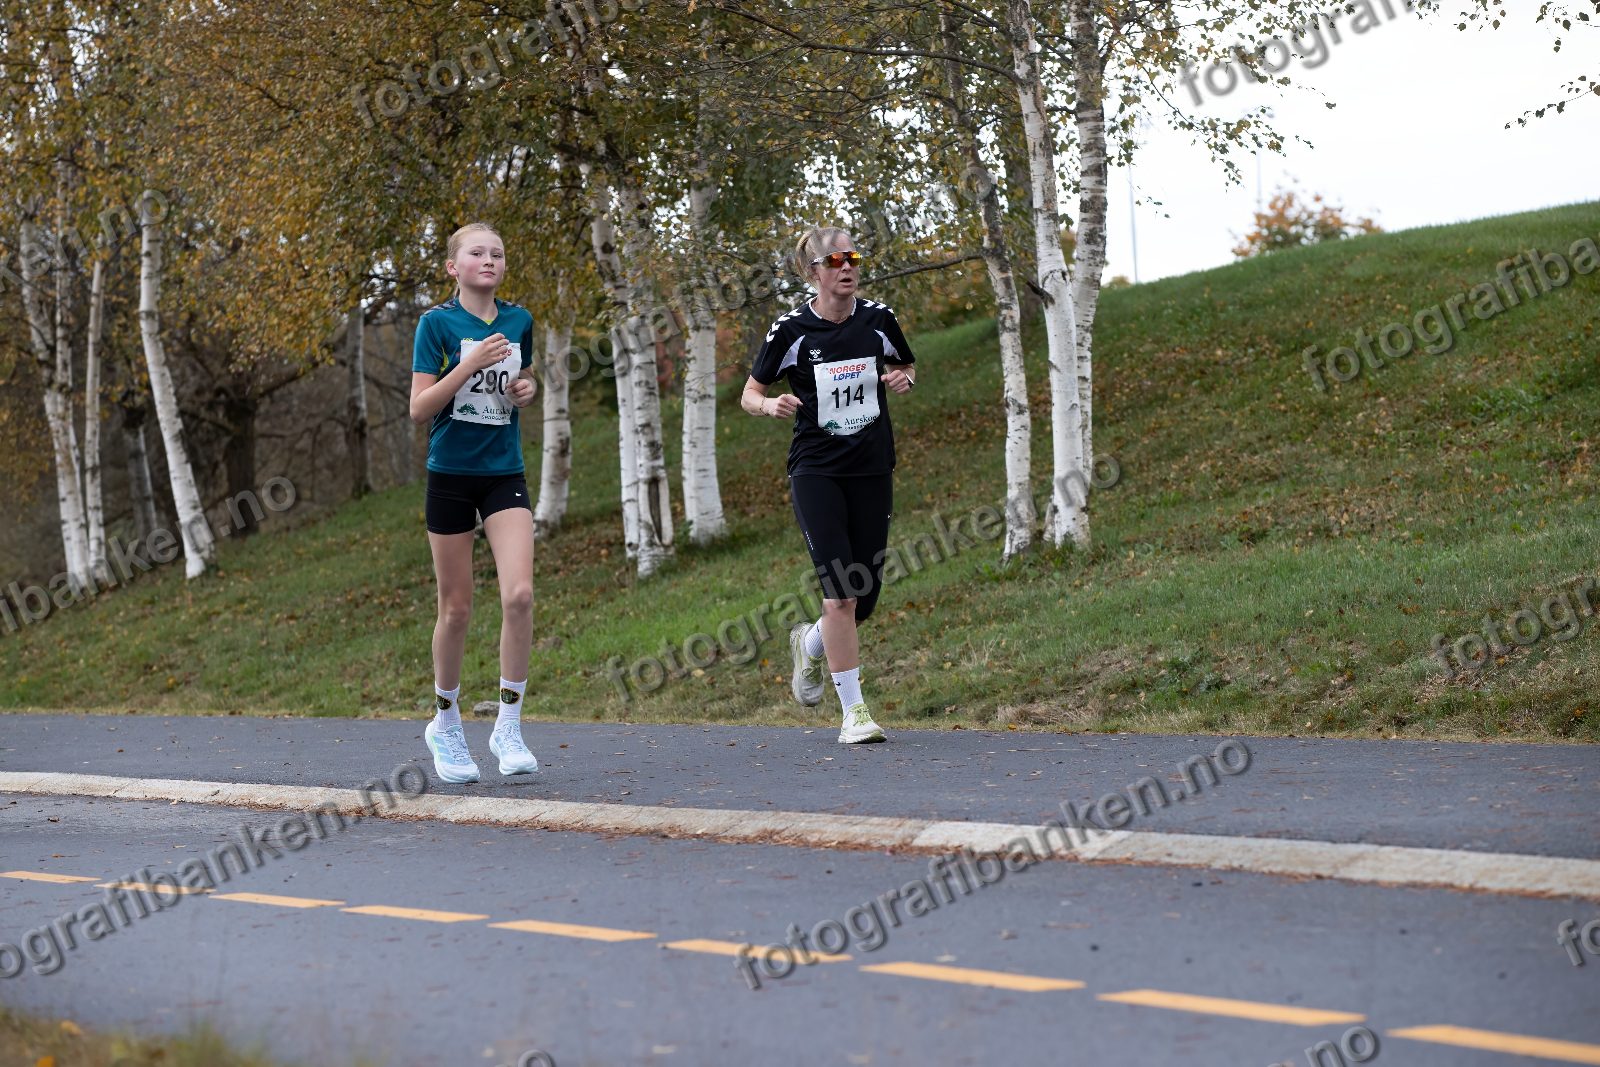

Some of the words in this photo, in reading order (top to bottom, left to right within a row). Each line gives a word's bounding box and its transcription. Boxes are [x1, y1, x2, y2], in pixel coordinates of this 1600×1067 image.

[830, 363, 867, 375] NORGES
[833, 371, 862, 381] LØPET
[470, 369, 509, 395] 290
[831, 384, 864, 408] 114
